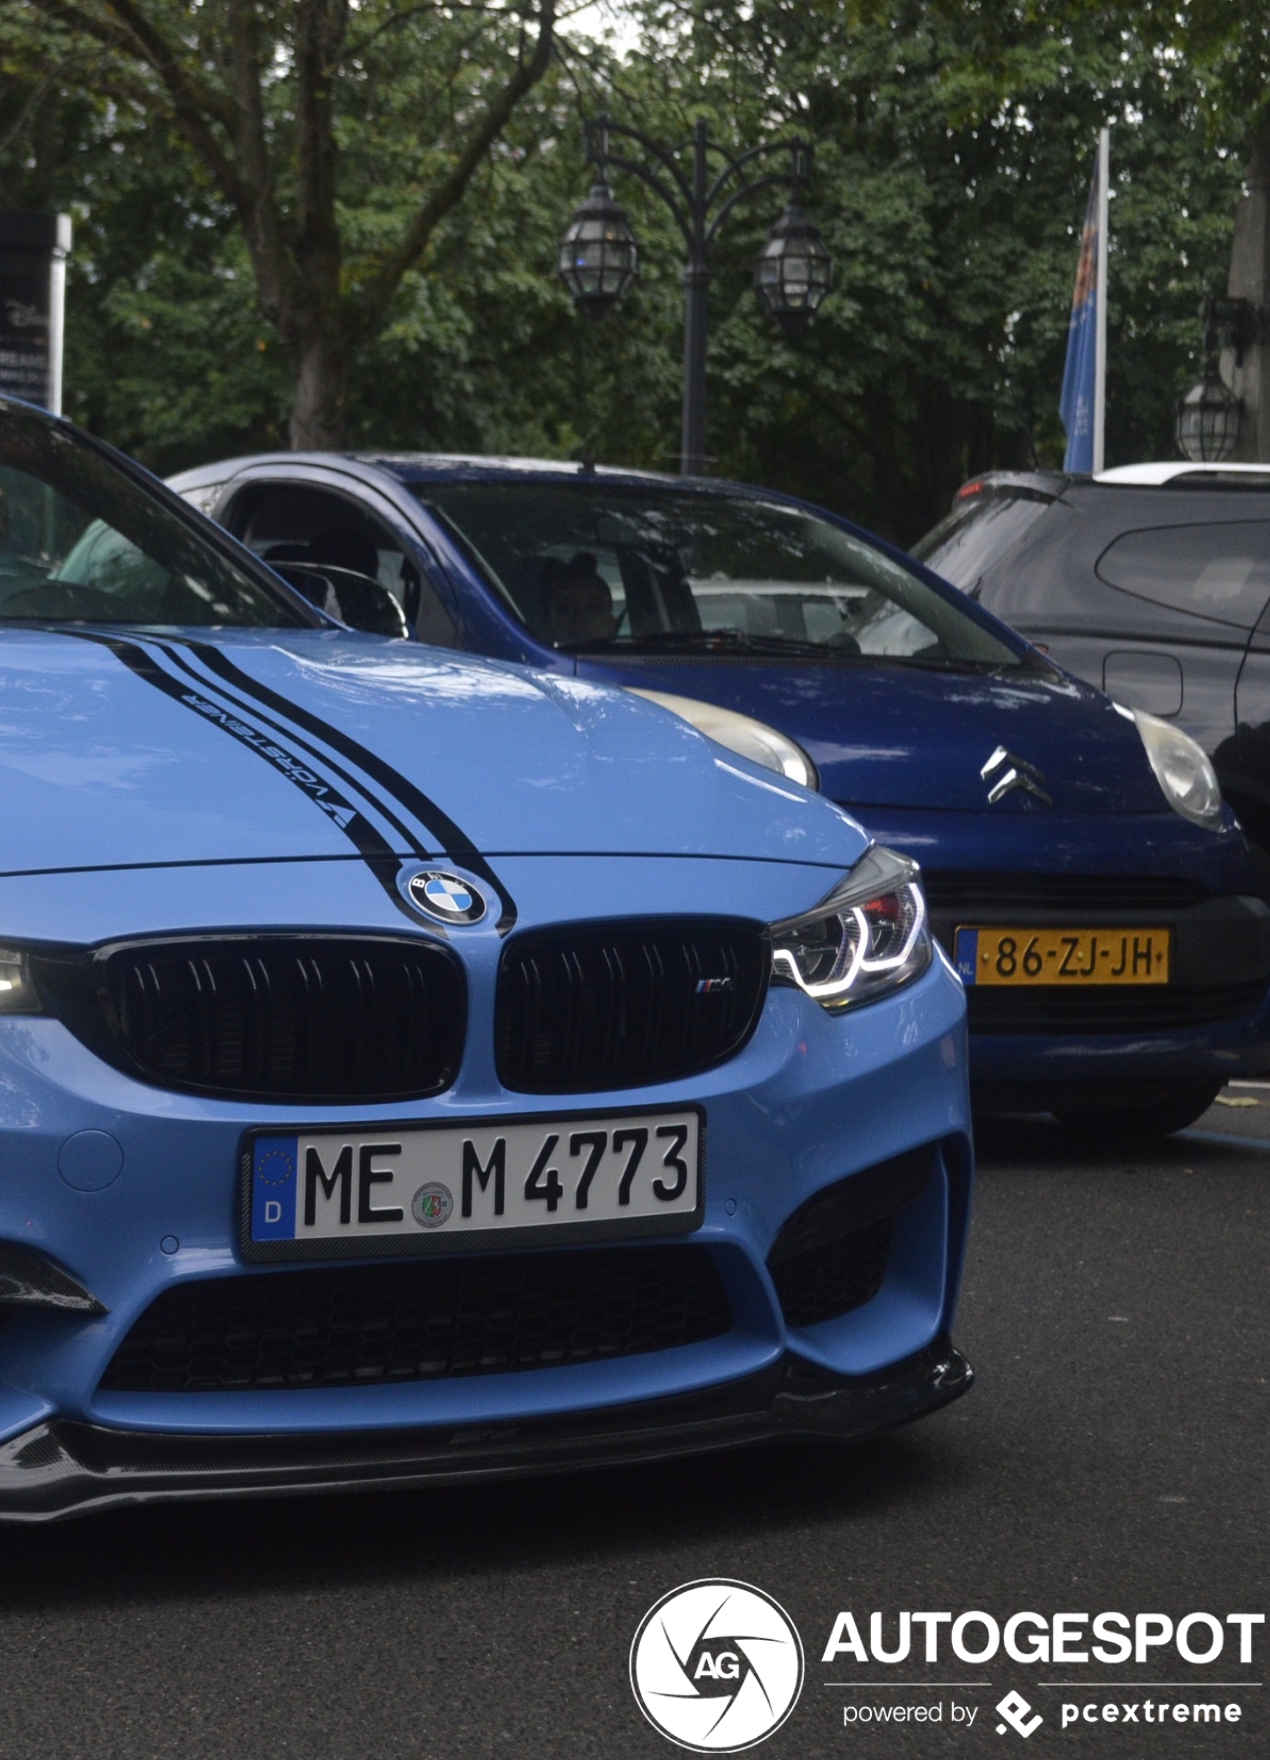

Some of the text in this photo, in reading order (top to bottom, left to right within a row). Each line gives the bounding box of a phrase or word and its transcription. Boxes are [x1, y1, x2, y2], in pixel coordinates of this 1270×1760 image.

[958, 963, 973, 976] NL
[995, 936, 1153, 977] 86-ZJ-JH
[304, 1142, 405, 1227] ME
[461, 1136, 507, 1218] M
[524, 1123, 690, 1213] 4773
[264, 1201, 282, 1224] D
